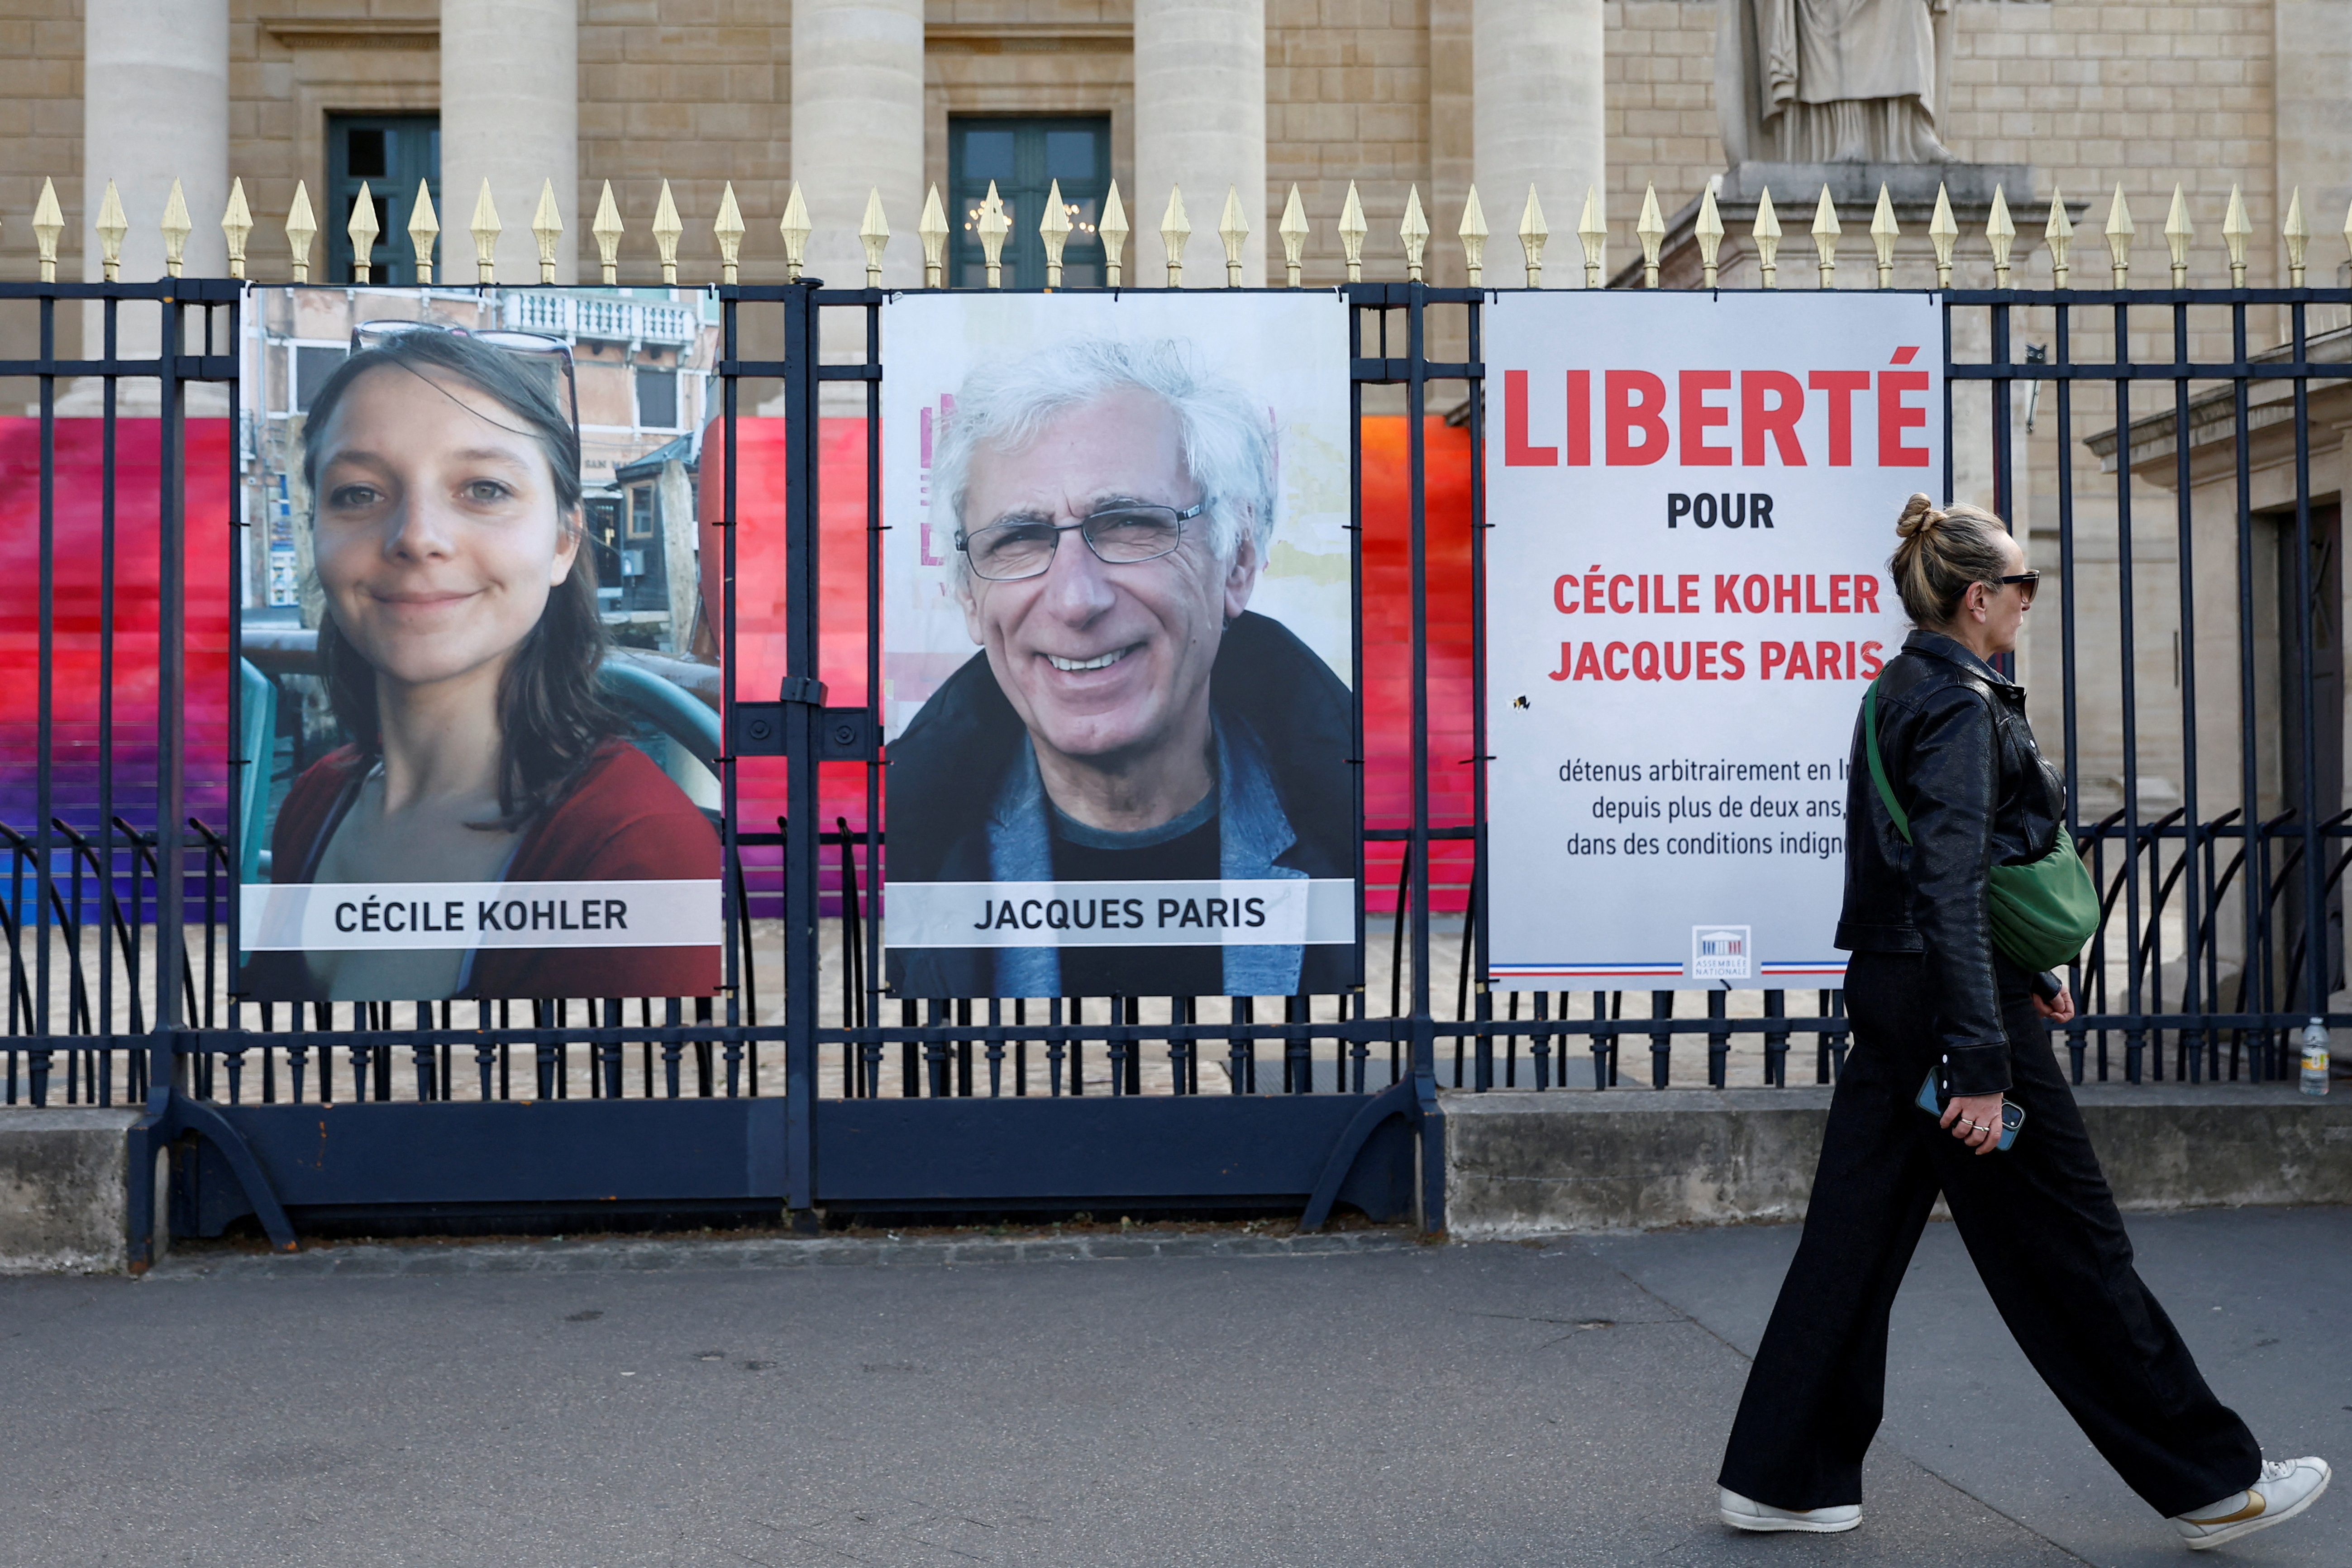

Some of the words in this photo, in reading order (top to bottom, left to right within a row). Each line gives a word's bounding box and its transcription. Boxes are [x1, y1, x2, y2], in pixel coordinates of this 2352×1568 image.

[1505, 346, 1929, 467] LIBERTÉ
[1668, 493, 1774, 529] POUR
[1554, 565, 1699, 614] CÉCILE
[1715, 574, 1880, 614] KOHLER
[1548, 641, 1745, 682] JACQUES
[1761, 640, 1884, 681] PARIS
[1559, 758, 1641, 782] détenus
[1649, 759, 1800, 782] arbitrairement
[1808, 764, 1831, 781] en
[1593, 796, 1660, 824] depuis
[1669, 796, 1712, 823] plus
[1719, 795, 1742, 818] de
[1750, 795, 1799, 817] deux
[1806, 800, 1846, 820] ans,
[1567, 833, 1616, 855] dans
[1624, 832, 1659, 855] des
[1667, 832, 1773, 855] conditions
[1780, 831, 1846, 859] indign
[335, 895, 464, 932] CÉCILE
[478, 900, 628, 931] KOHLER
[974, 899, 1144, 930] JACQUES
[1159, 898, 1265, 928] PARIS
[1696, 959, 1746, 967] ASSEMBLÉE
